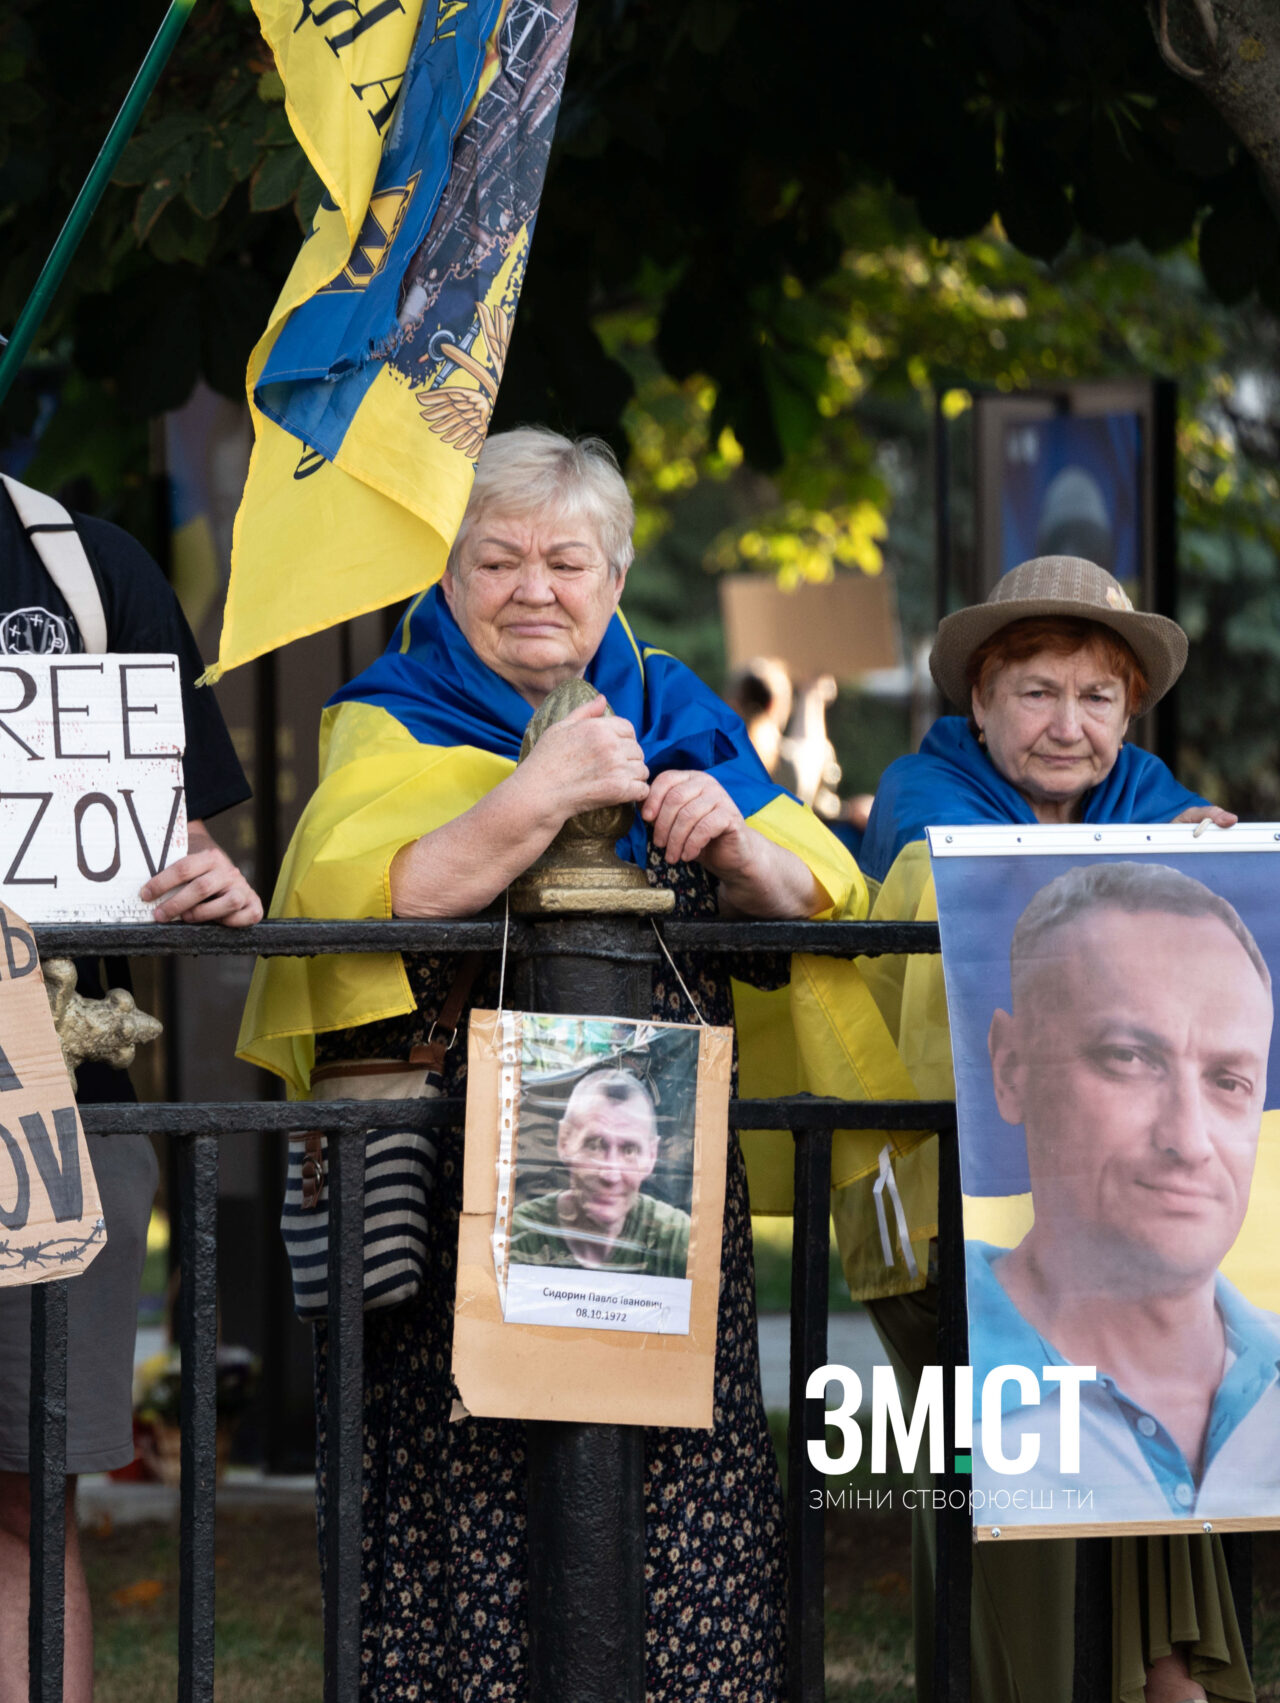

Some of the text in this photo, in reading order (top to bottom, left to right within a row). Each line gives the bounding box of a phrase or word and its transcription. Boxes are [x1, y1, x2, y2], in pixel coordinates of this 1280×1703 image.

[542, 1287, 587, 1302] Сидорин
[588, 1292, 618, 1305] Павло
[575, 1307, 627, 1322] 08.10.1972
